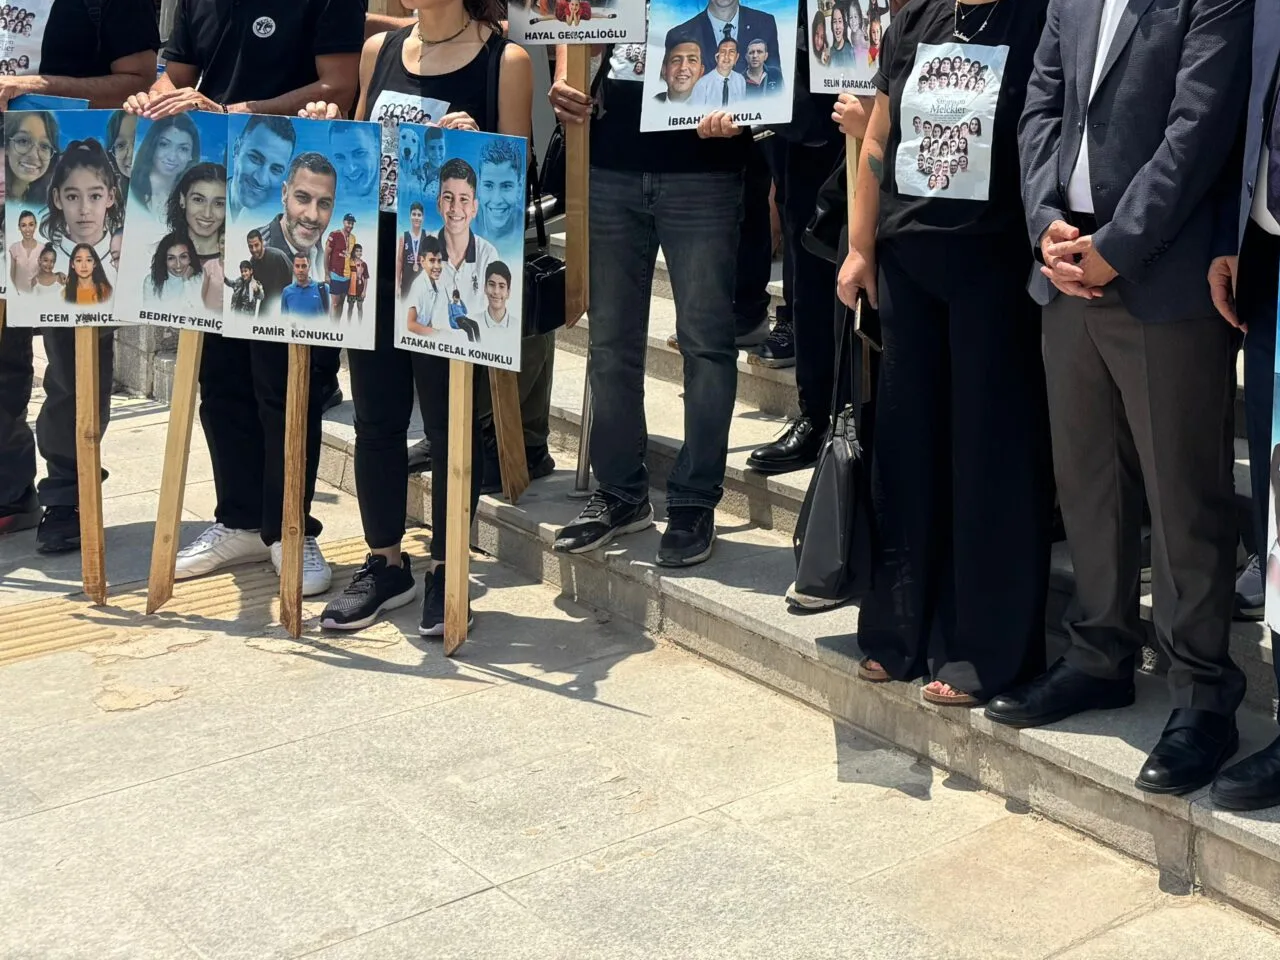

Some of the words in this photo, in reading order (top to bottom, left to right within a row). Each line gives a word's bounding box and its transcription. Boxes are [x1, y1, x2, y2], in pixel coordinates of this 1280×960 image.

[525, 31, 555, 40] HAYAL
[824, 78, 839, 87] SELİN
[40, 314, 69, 323] ECEM
[139, 311, 185, 325] BEDRİYE
[252, 326, 285, 337] PAMİR
[291, 329, 344, 342] KONUKLU
[400, 336, 435, 352] ATAKAN
[438, 343, 466, 356] CELAL
[468, 348, 513, 366] KONUKLU
